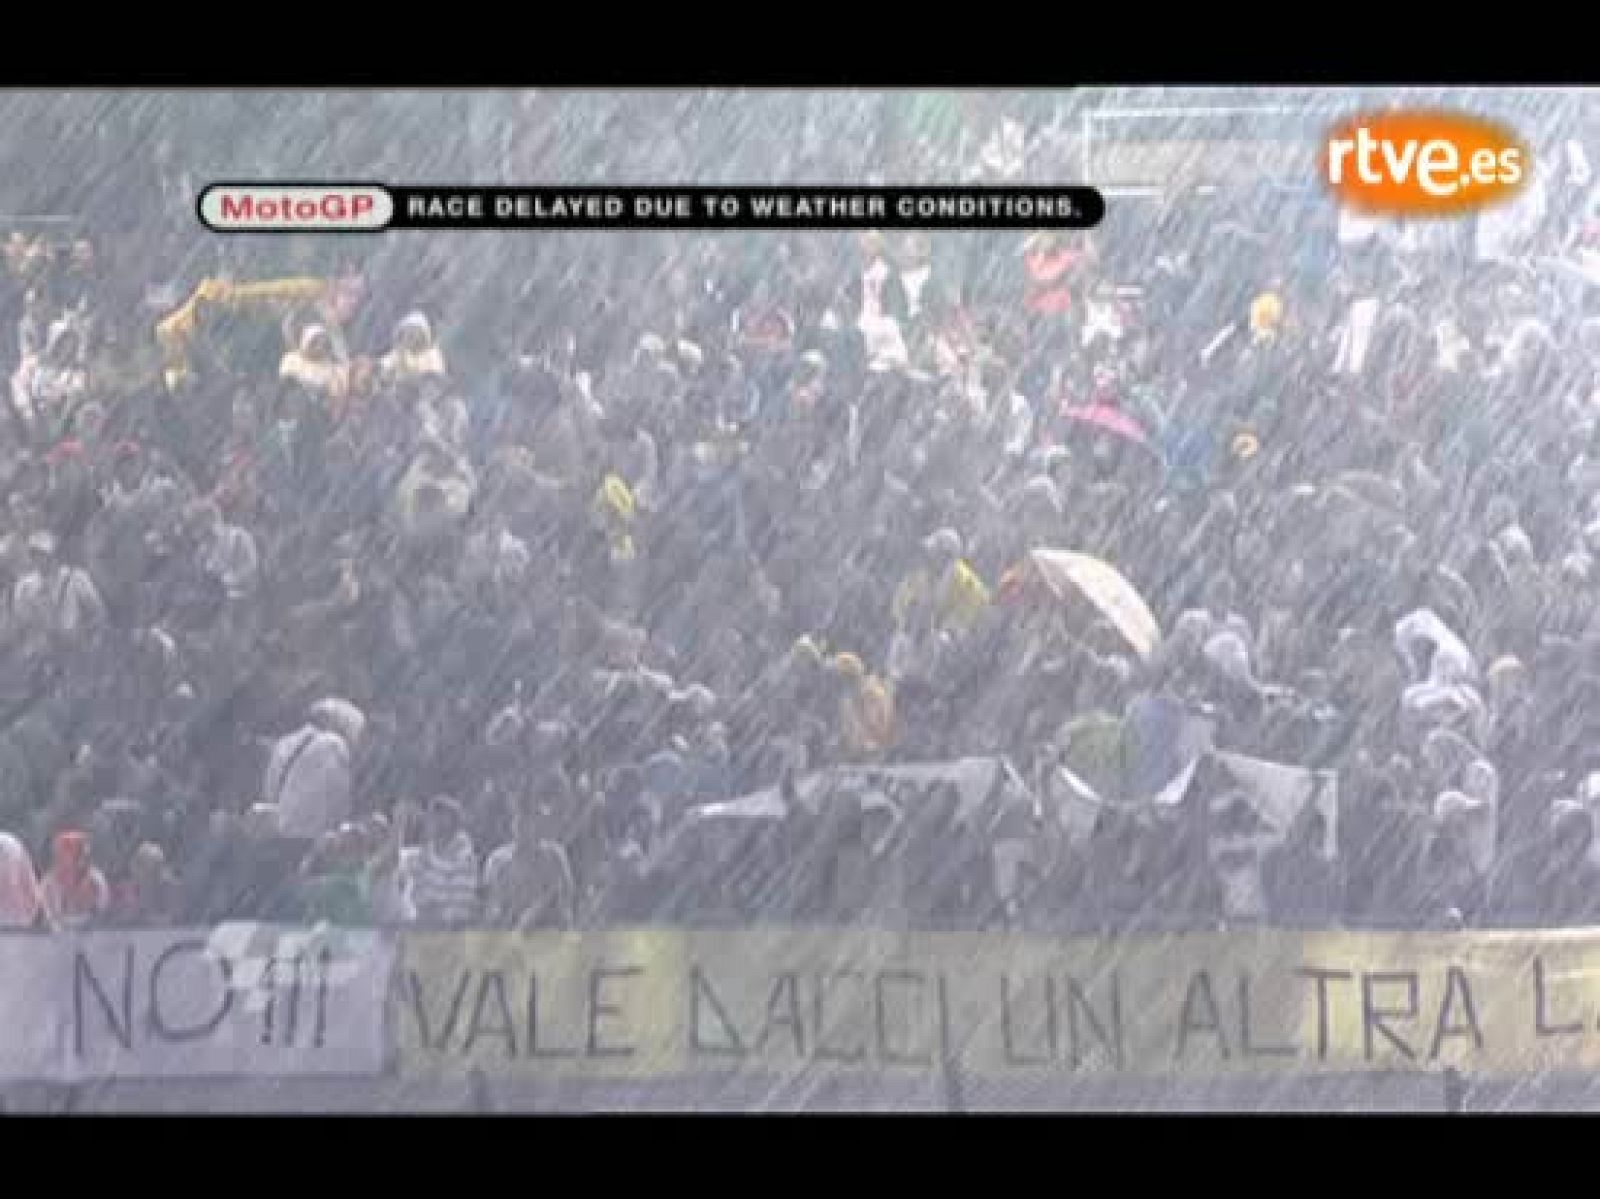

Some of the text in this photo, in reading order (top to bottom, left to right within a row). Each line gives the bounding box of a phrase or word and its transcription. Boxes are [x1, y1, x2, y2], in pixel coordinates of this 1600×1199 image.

[405, 964, 646, 1058] VALE
[998, 966, 1124, 1070] UN
[1174, 964, 1483, 1062] ALTRA
[1532, 952, 1600, 1040] L
